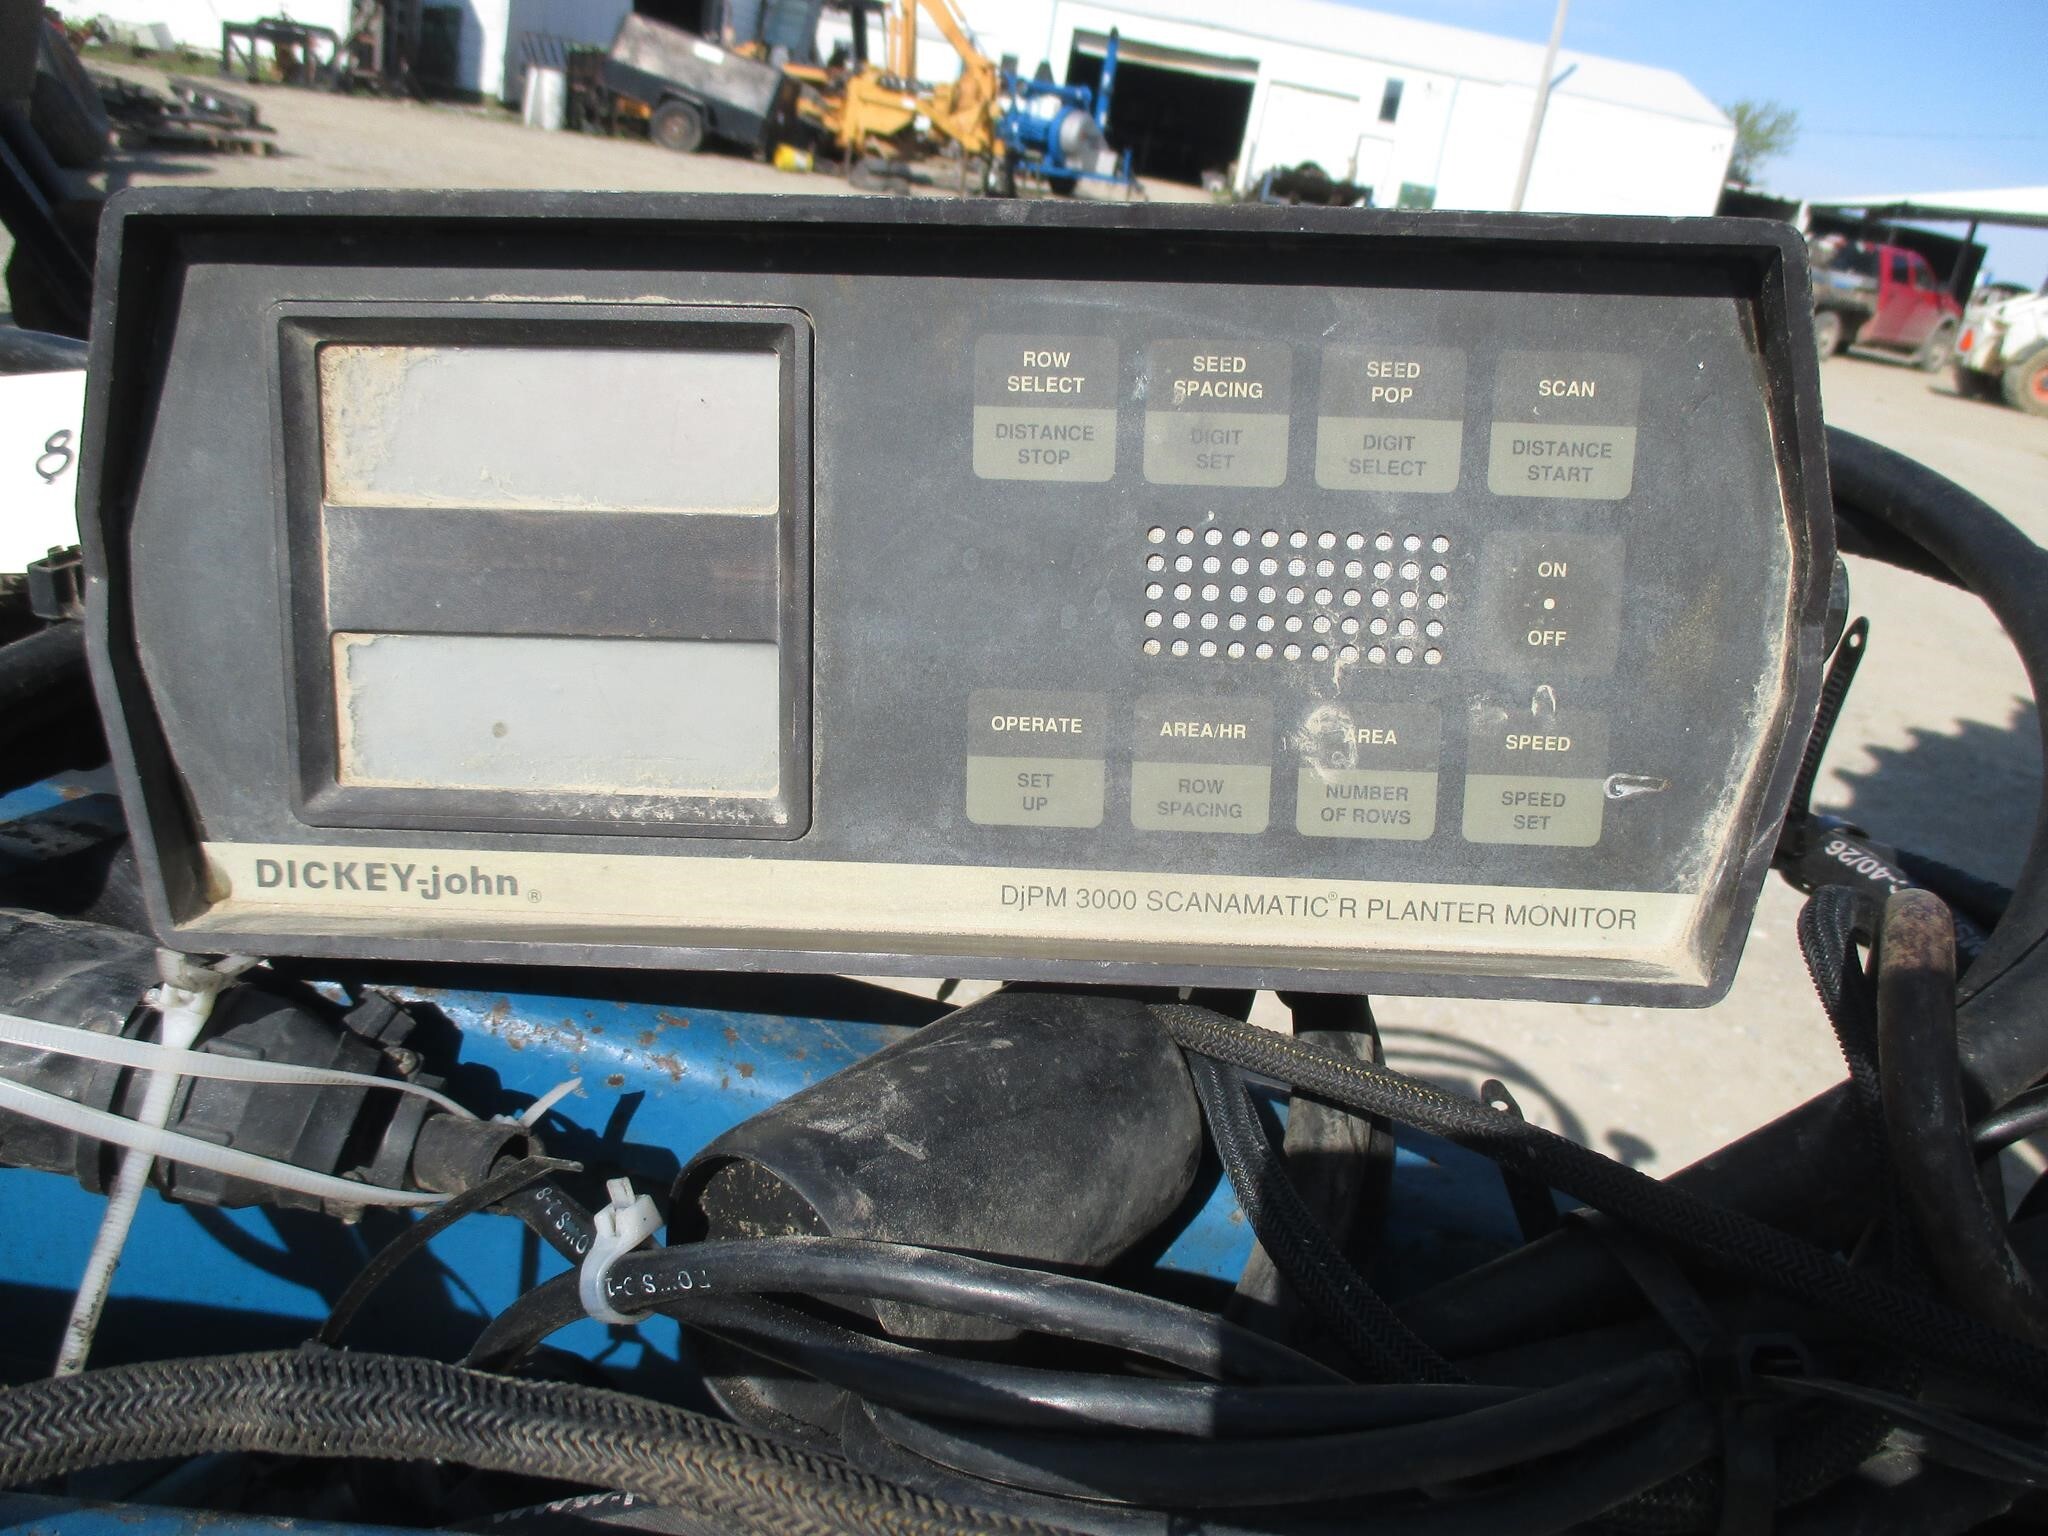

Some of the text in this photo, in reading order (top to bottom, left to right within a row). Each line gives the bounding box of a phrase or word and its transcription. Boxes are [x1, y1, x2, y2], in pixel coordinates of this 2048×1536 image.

[1022, 351, 1071, 369] ROW
[1192, 355, 1248, 375] SEED
[1366, 360, 1421, 380] SEED
[1006, 374, 1086, 395] SELECT
[1173, 379, 1264, 400] SPACING
[1370, 385, 1415, 404] POP
[1537, 379, 1597, 399] SCAN
[994, 422, 1096, 443] DISTANCE
[1190, 427, 1244, 447] DIGIT
[1362, 433, 1417, 453] DIGIT
[1511, 439, 1613, 460] DISTANCE
[1017, 447, 1071, 467] STOP
[1195, 452, 1236, 471] SET
[1348, 458, 1427, 478] SELECT
[1526, 464, 1594, 484] START
[1536, 561, 1568, 579] ON
[1527, 629, 1567, 647] OFF
[990, 715, 1083, 735] OPERATE
[1159, 720, 1248, 741] AREA/HR
[1342, 727, 1398, 746] AREA
[1505, 733, 1572, 753] SPEED
[1016, 772, 1054, 790] SET
[1177, 776, 1225, 795] ROW
[1324, 783, 1410, 803] NUMBER
[1500, 789, 1567, 809] SPEED
[1021, 795, 1049, 812] UP
[1156, 800, 1243, 820] SPACING
[1320, 806, 1412, 826] OF ROWS
[1512, 813, 1551, 832] SET
[255, 857, 519, 901] DICKEY-john
[999, 883, 1068, 912] DjPM
[1075, 886, 1138, 911] 3000
[1366, 898, 1496, 926] PLANTER
[1504, 902, 1637, 931] MONITOR
